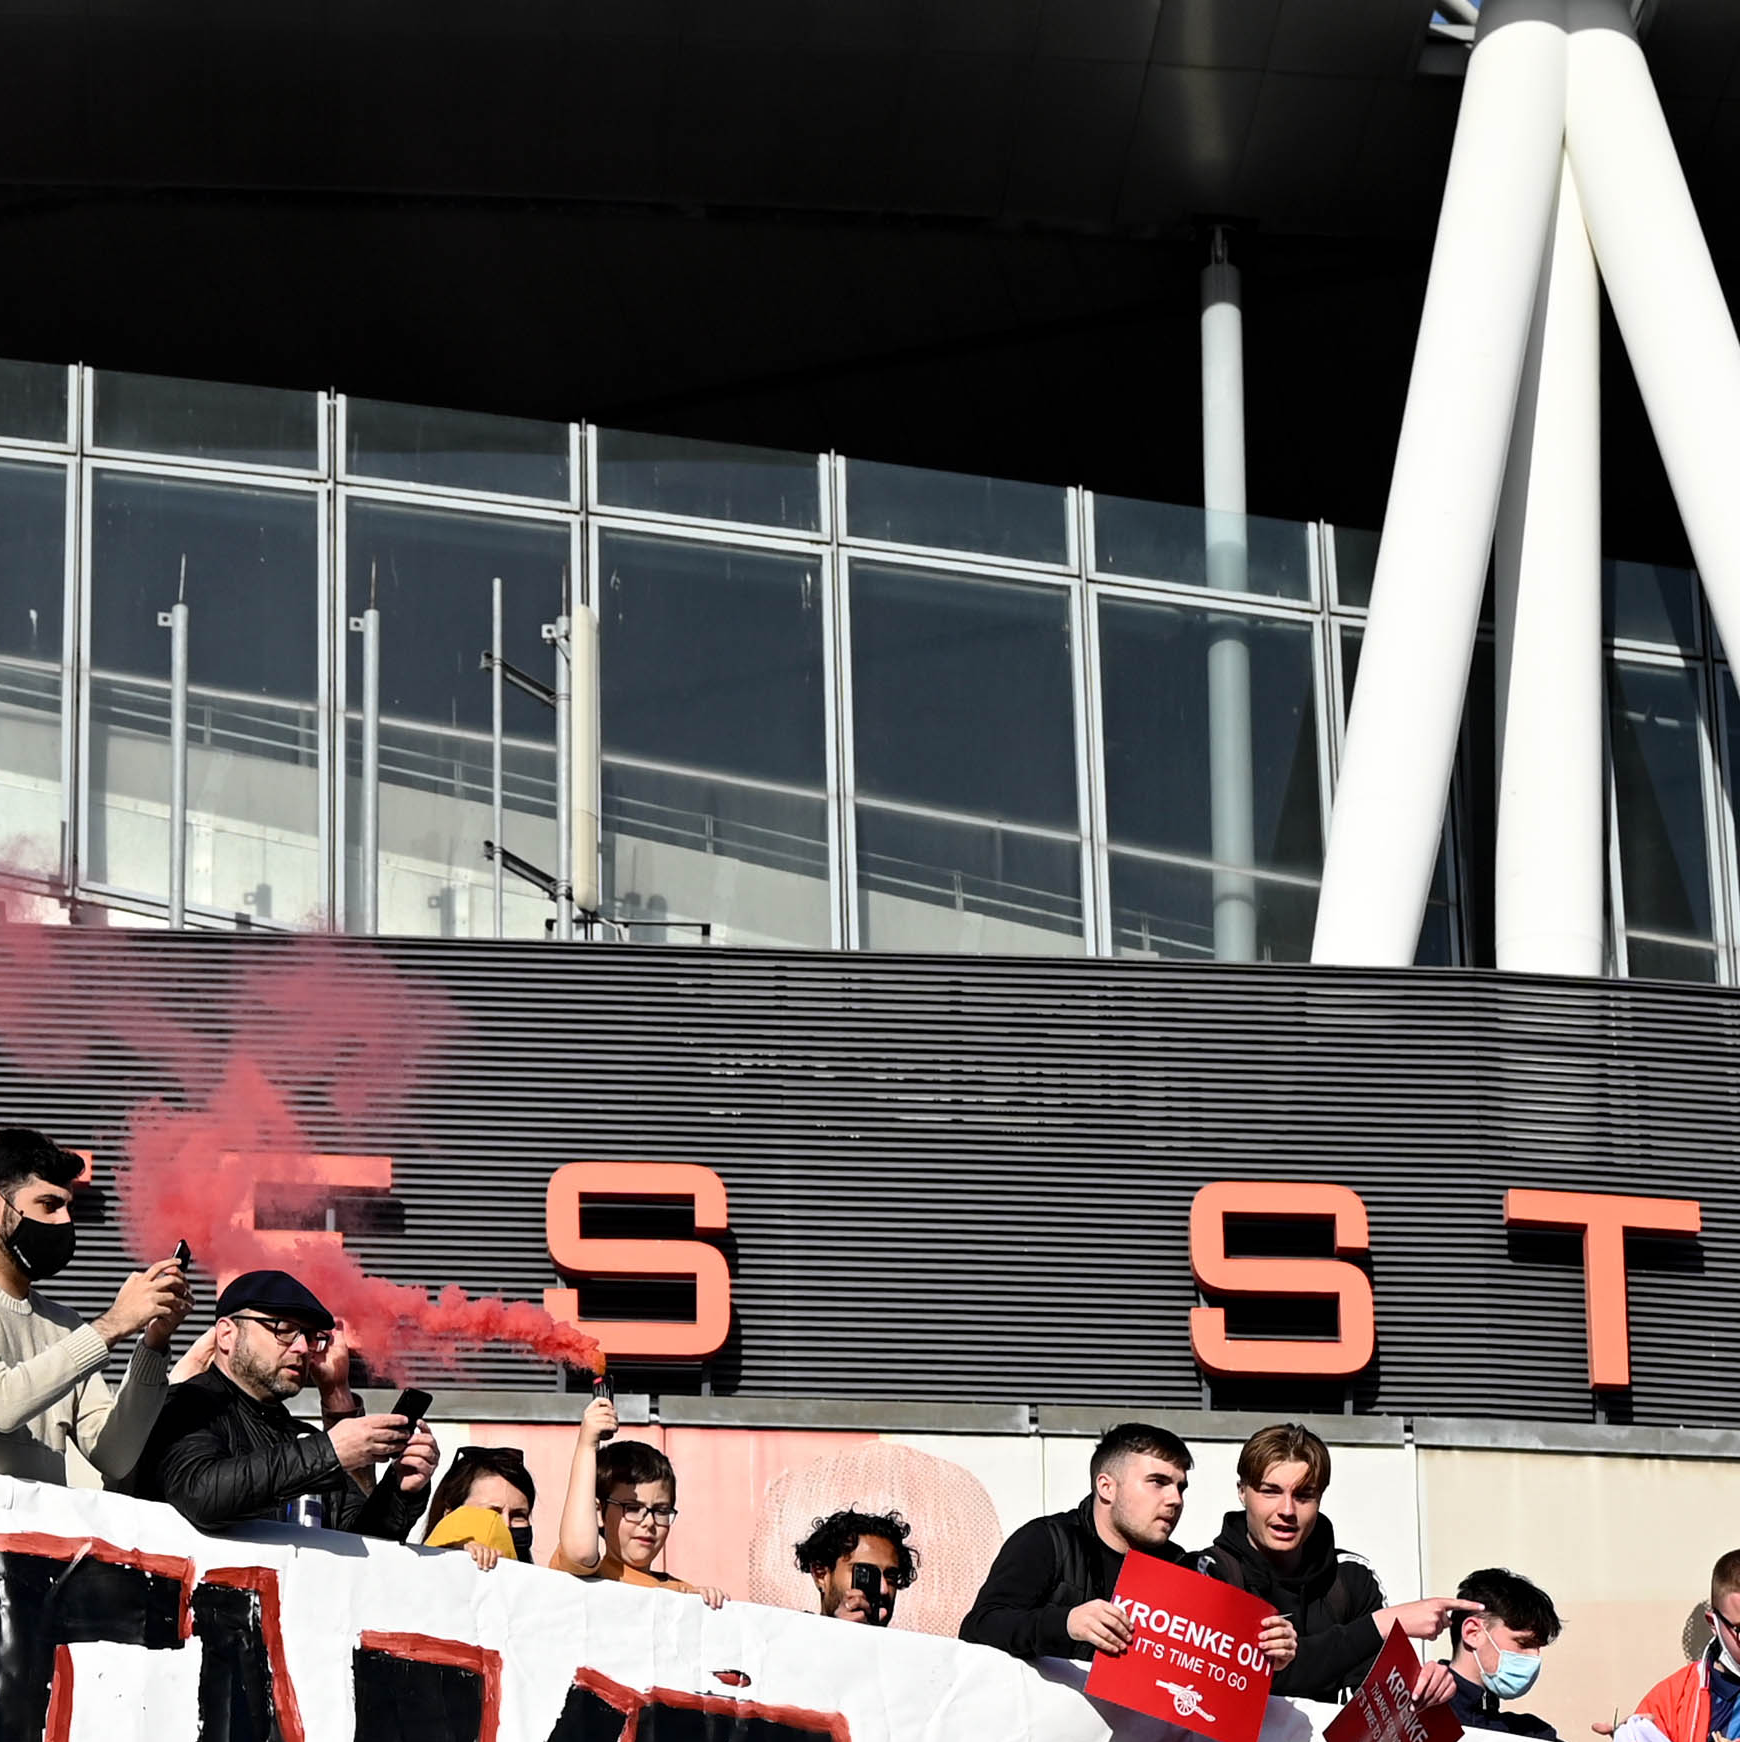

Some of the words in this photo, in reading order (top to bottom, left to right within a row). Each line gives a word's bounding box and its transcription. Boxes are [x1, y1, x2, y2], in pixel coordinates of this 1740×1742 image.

[1134, 1637, 1165, 1660] IT'S
[1169, 1648, 1205, 1674] TIME
[1208, 1662, 1226, 1683] TO
[1227, 1671, 1248, 1692] GO
